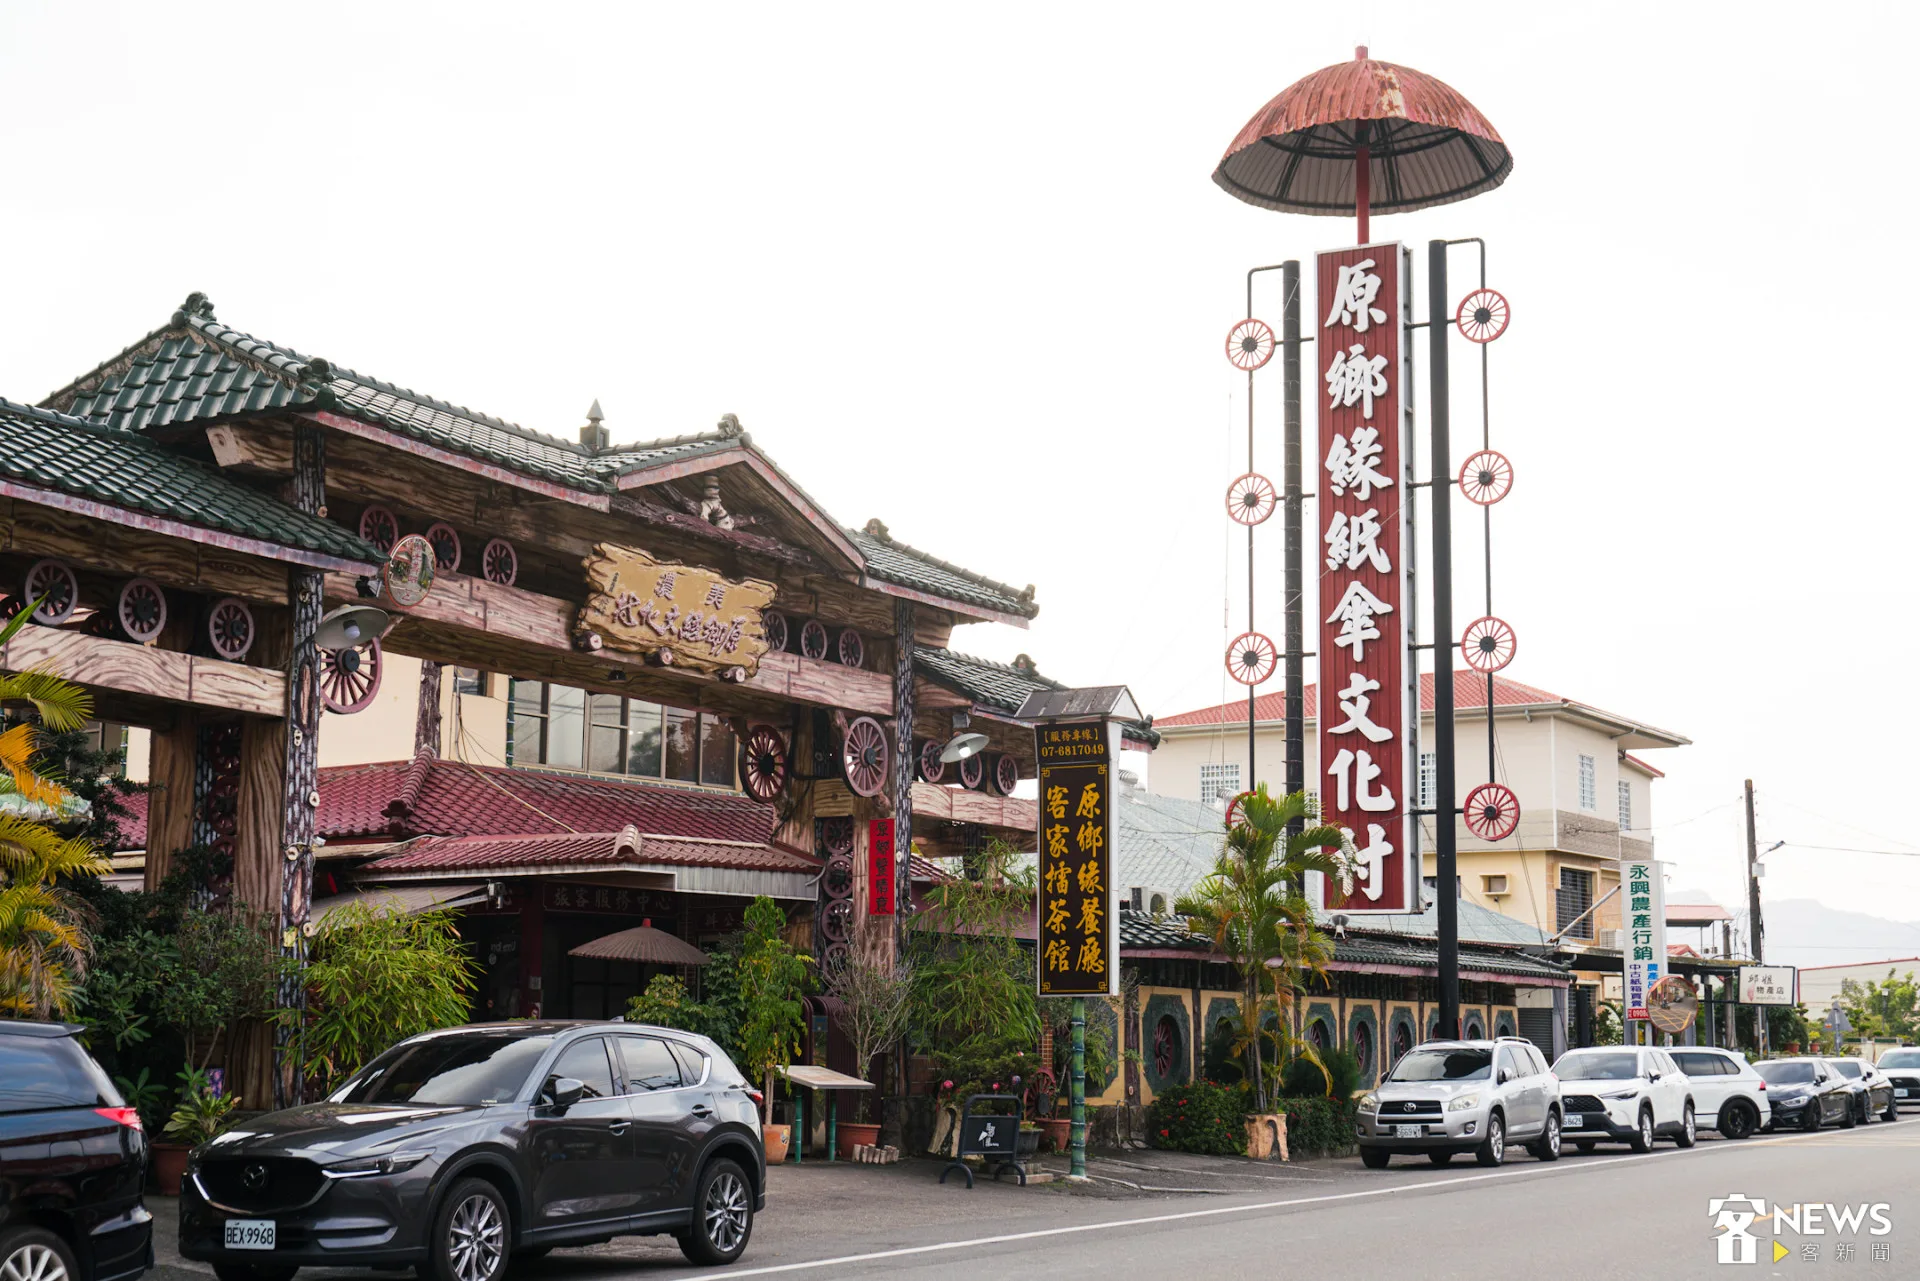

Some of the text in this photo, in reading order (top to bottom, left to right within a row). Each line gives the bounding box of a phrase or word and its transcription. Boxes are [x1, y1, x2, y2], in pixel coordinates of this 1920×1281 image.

[1325, 258, 1394, 902] 原鄉緣紙傘文化村
[1041, 743, 1105, 757] 07-6817049
[553, 886, 672, 913] 旅客服務中心
[1045, 784, 1072, 975] 客家擂茶館
[1075, 782, 1105, 975] 原鄉緣餐廳
[1629, 864, 1653, 961] 永興農產行銷
[1629, 963, 1642, 1008] 中古紙箱買賣
[1756, 986, 1784, 995] 物產店
